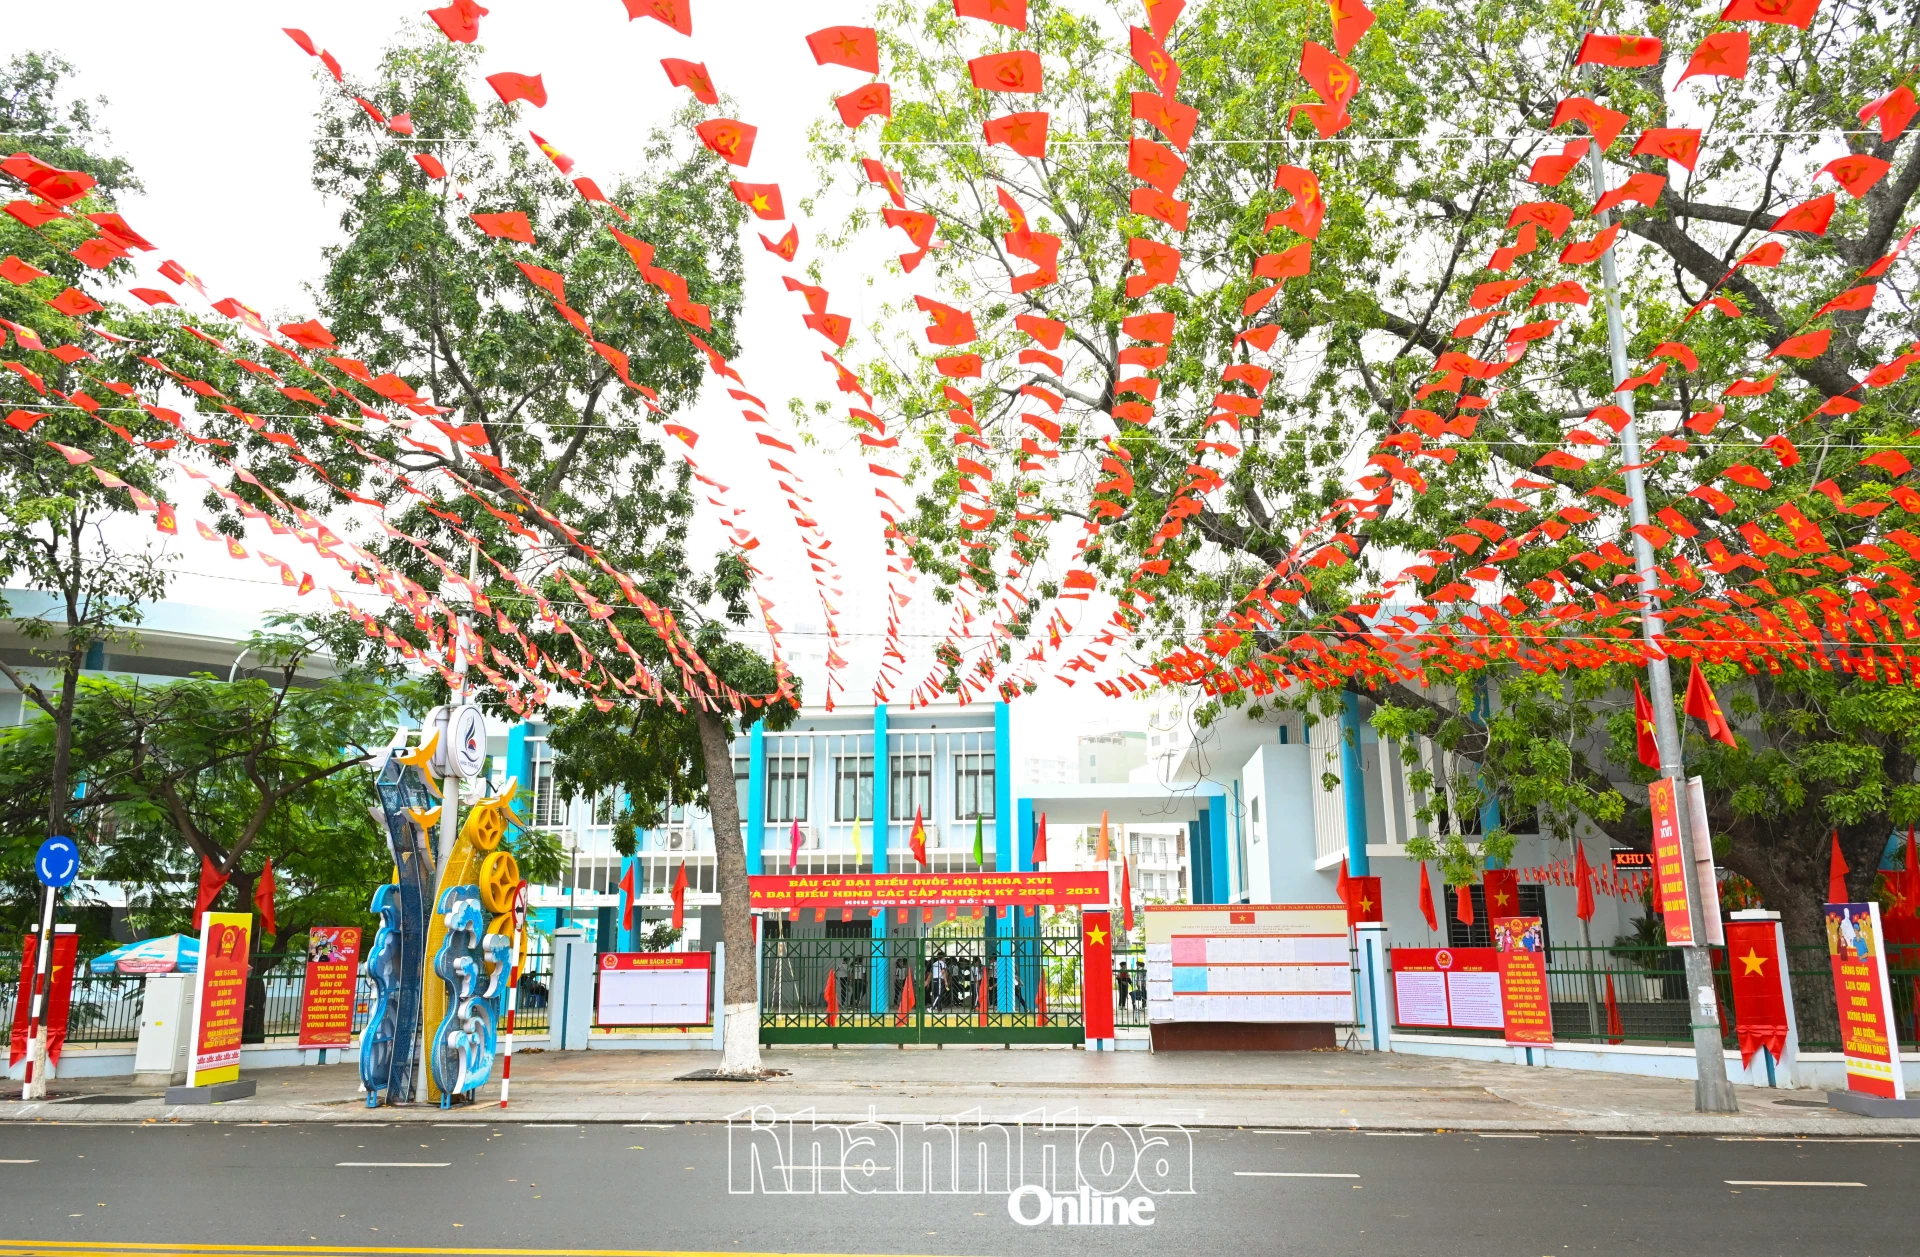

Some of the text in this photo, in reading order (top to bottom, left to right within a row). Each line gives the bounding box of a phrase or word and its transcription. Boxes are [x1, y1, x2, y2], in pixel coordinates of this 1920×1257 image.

[1660, 826, 1672, 838] XVI
[1616, 854, 1644, 864] KHU
[789, 878, 818, 887] BẦU
[823, 877, 842, 886] CỬ
[846, 879, 870, 888] ĐẠI
[875, 877, 908, 886] BIỂU
[913, 876, 949, 886] QUỐC
[953, 877, 977, 886] HỘI
[982, 876, 1022, 885] KHÓA
[767, 891, 791, 899] ĐẠI
[796, 889, 829, 898] BIỂU
[876, 888, 905, 897] CÁC
[909, 888, 937, 897] CẤP
[942, 888, 991, 897] NHIỆM
[994, 888, 1015, 896] KỲ
[1841, 964, 1869, 976] SÁNG SUỐT
[1856, 981, 1870, 993] CHỌN
[1846, 1041, 1856, 1051] CHO
